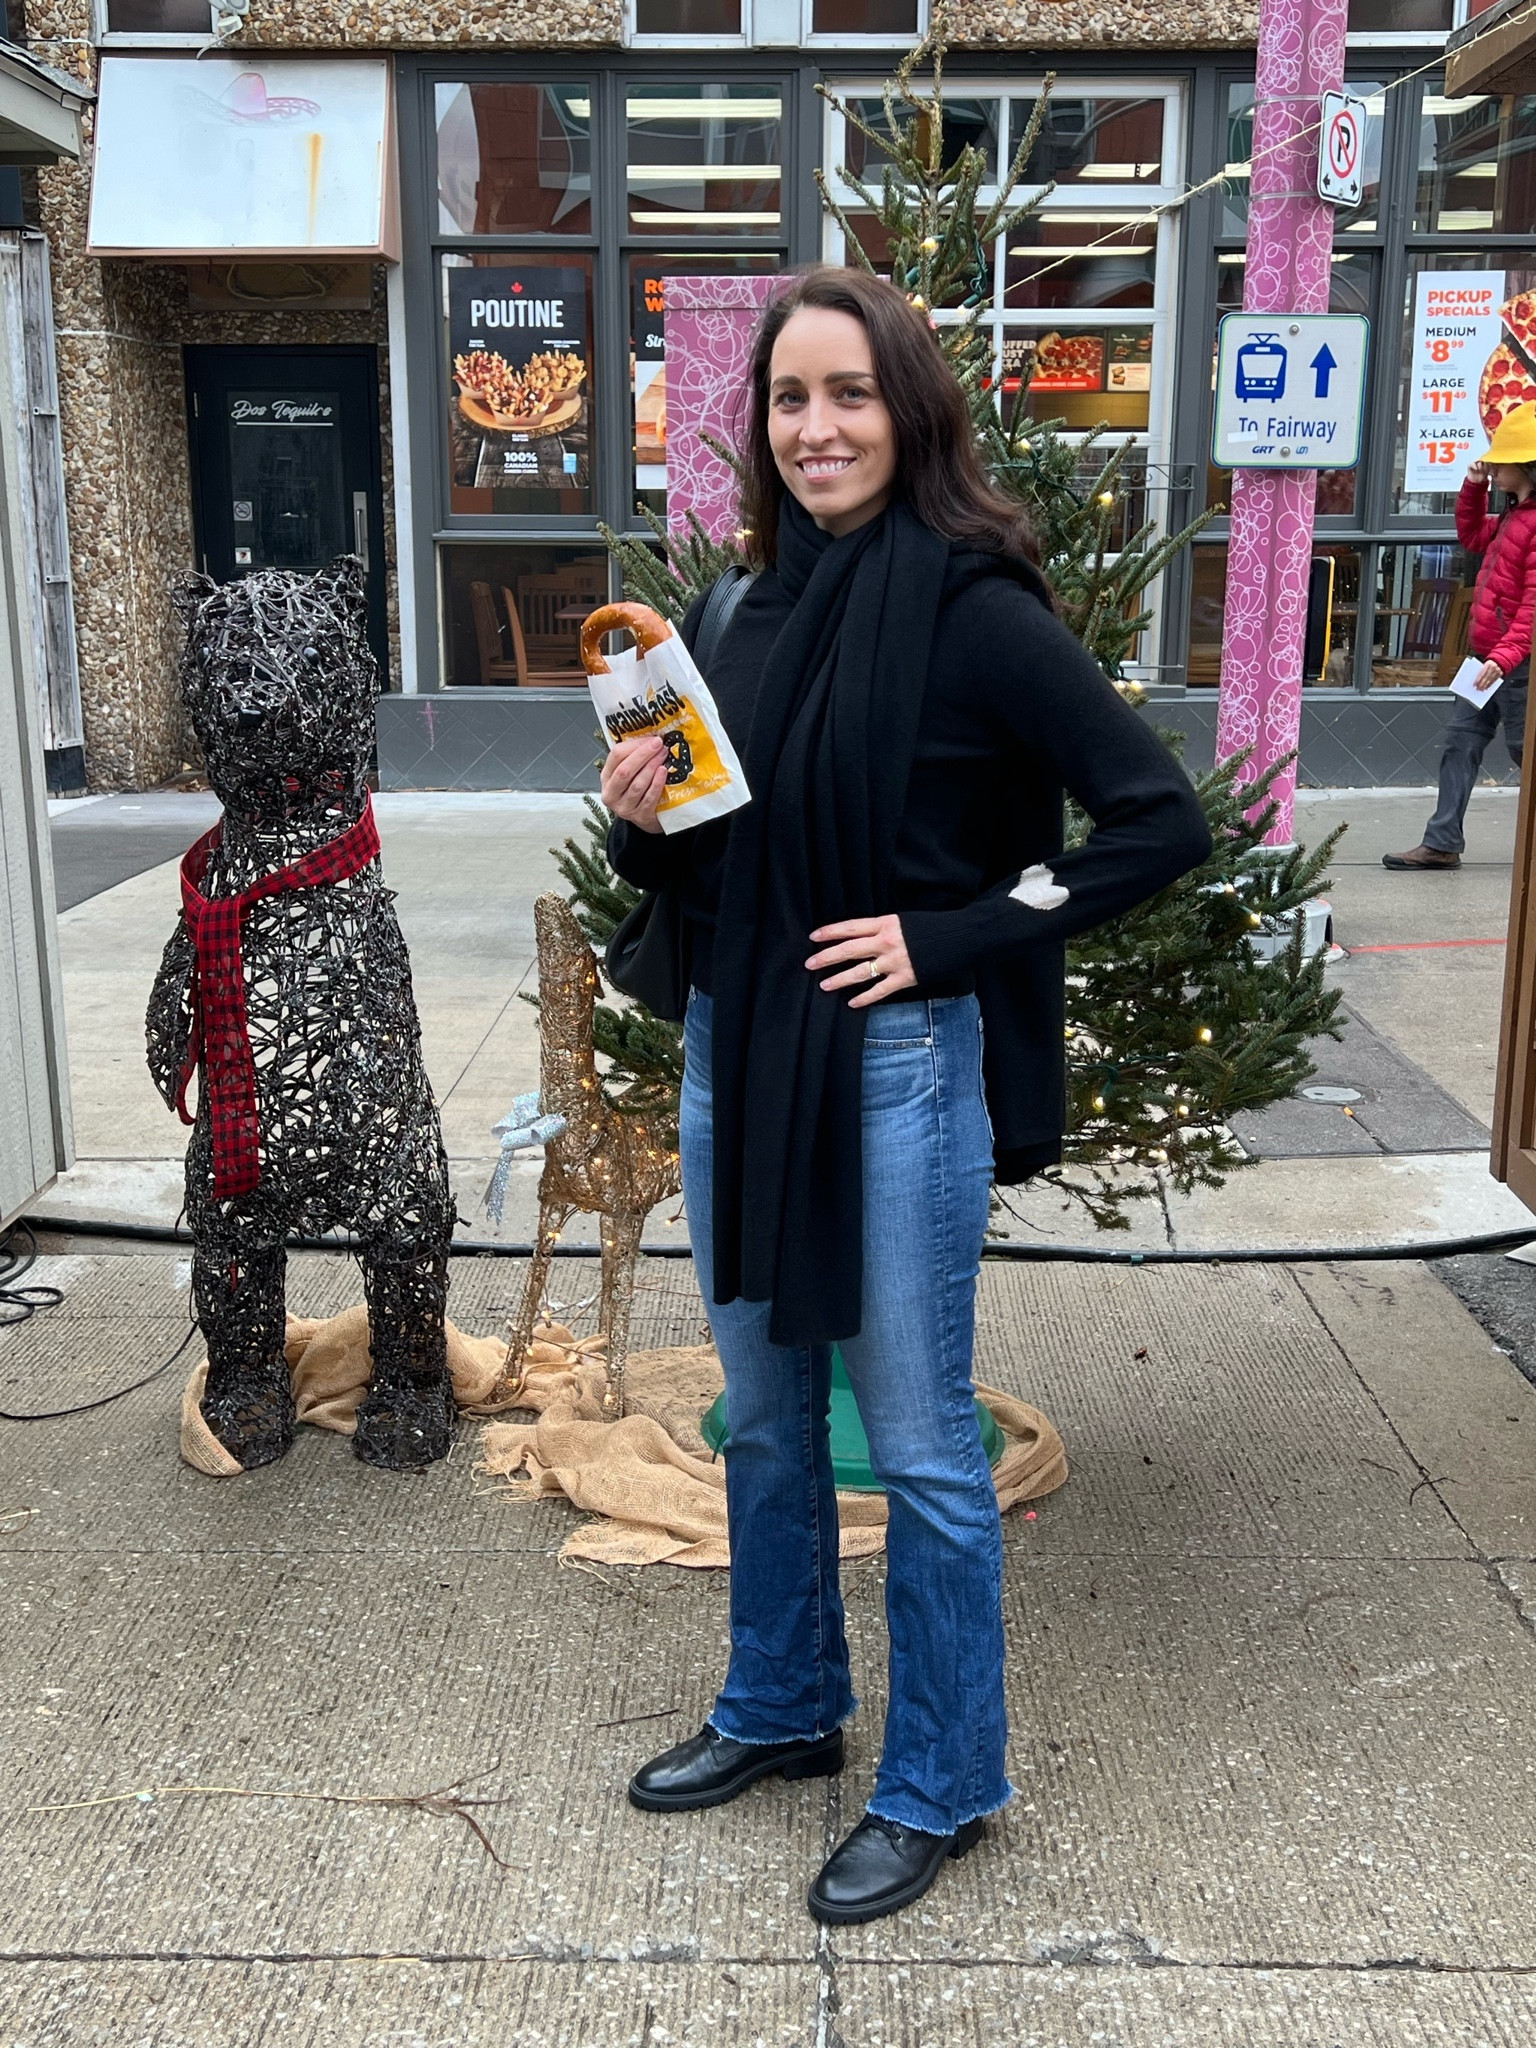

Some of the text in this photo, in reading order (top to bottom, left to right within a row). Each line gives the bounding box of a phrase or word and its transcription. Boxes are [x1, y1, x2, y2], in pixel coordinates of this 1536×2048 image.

[1428, 291, 1492, 303] PICKUP
[471, 300, 564, 328] POUTINE
[1427, 306, 1491, 316] SPECIALS
[1426, 327, 1476, 336] MEDIUM
[987, 340, 1037, 349] SUFFED
[1422, 378, 1465, 388] LARGE
[231, 400, 267, 419] Dos
[1239, 416, 1337, 443] To Fairway
[1420, 429, 1475, 439] X-LARGE
[1252, 446, 1275, 454] GRT
[504, 452, 538, 463] 100%
